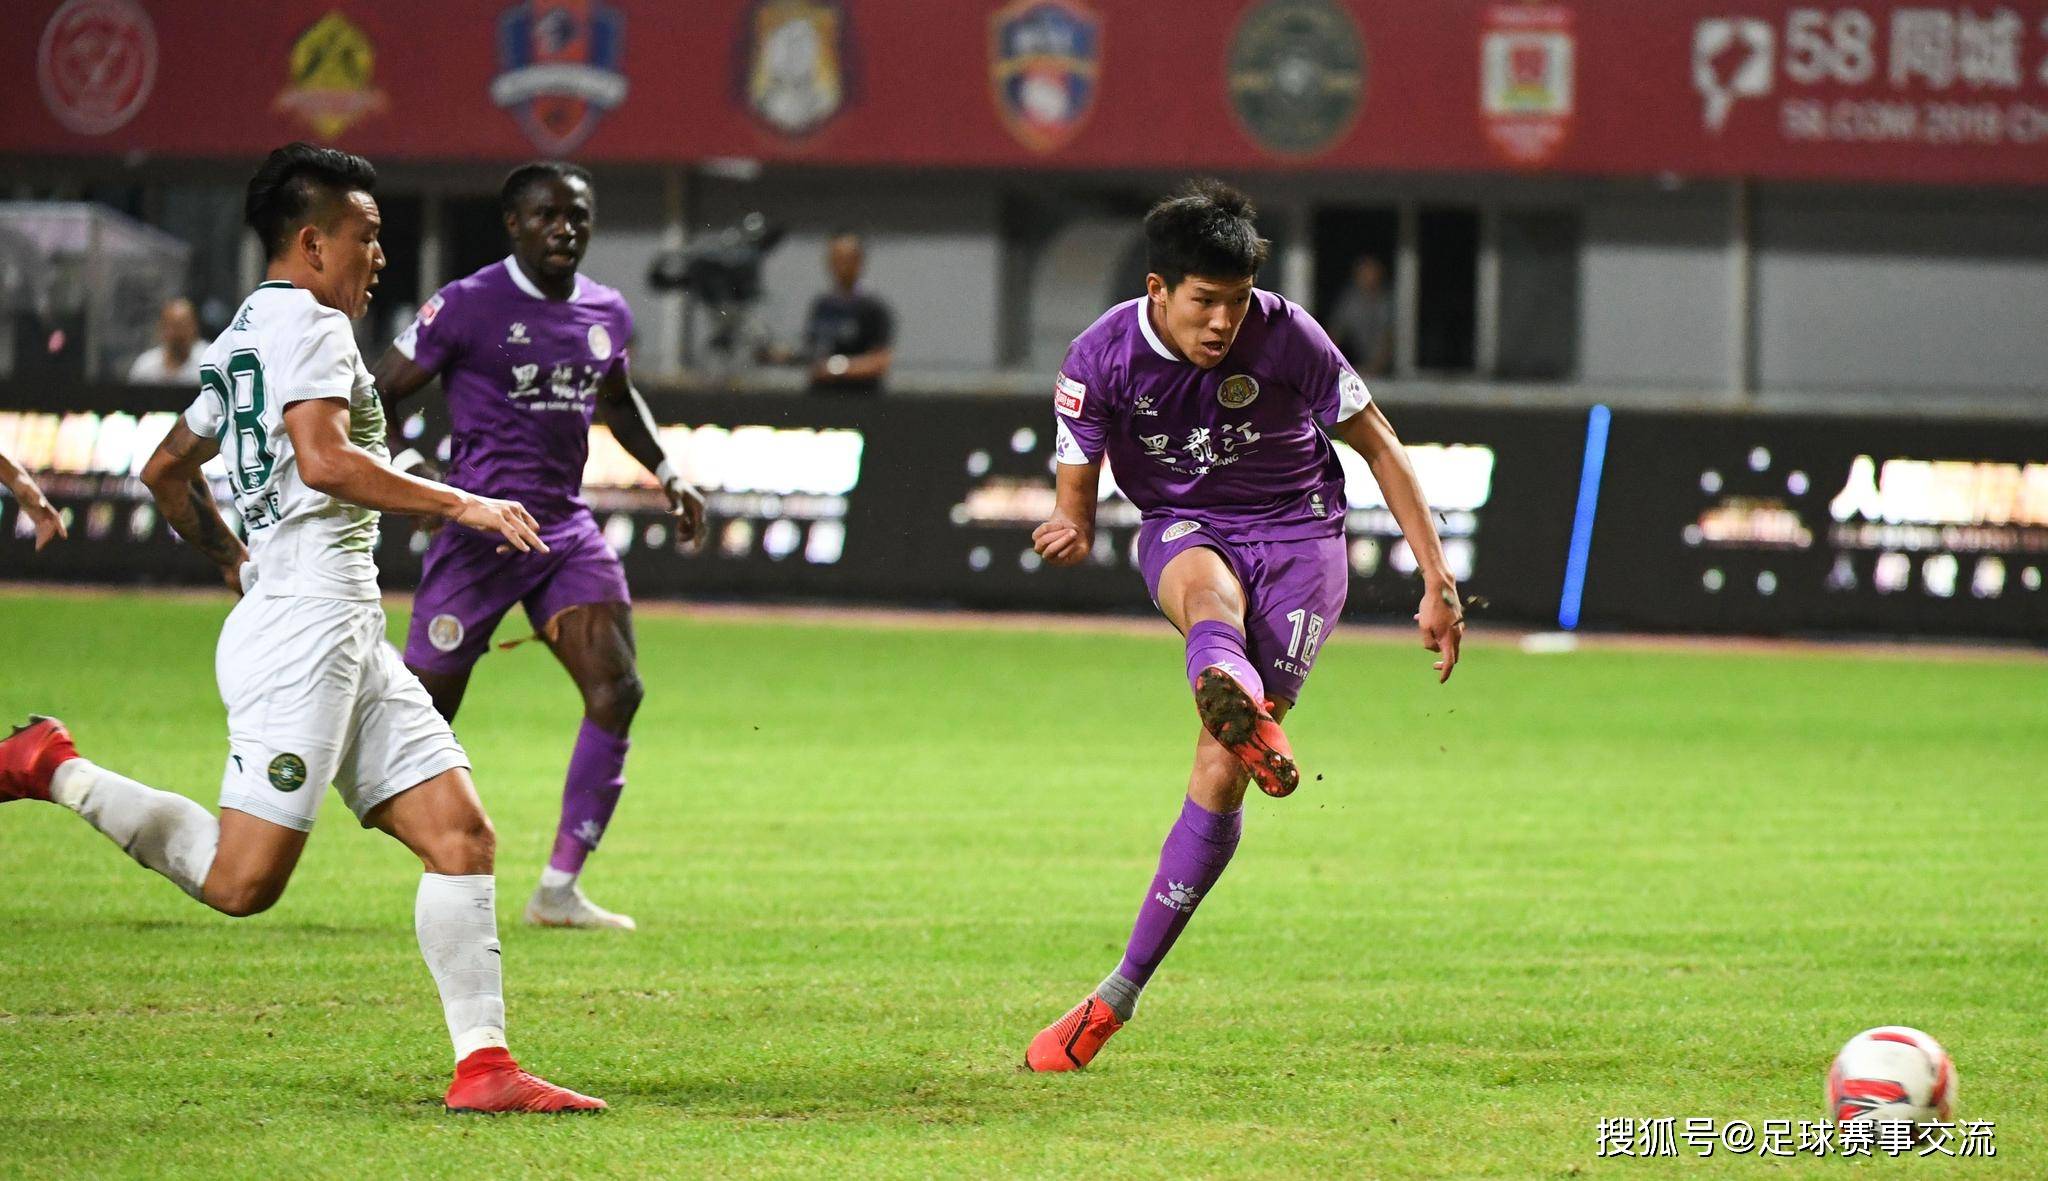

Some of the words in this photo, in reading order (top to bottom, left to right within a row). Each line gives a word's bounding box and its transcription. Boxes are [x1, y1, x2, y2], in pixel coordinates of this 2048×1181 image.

[1786, 9, 1874, 84] 58
[1892, 9, 2020, 88] 同城
[1286, 608, 1324, 667] 18
